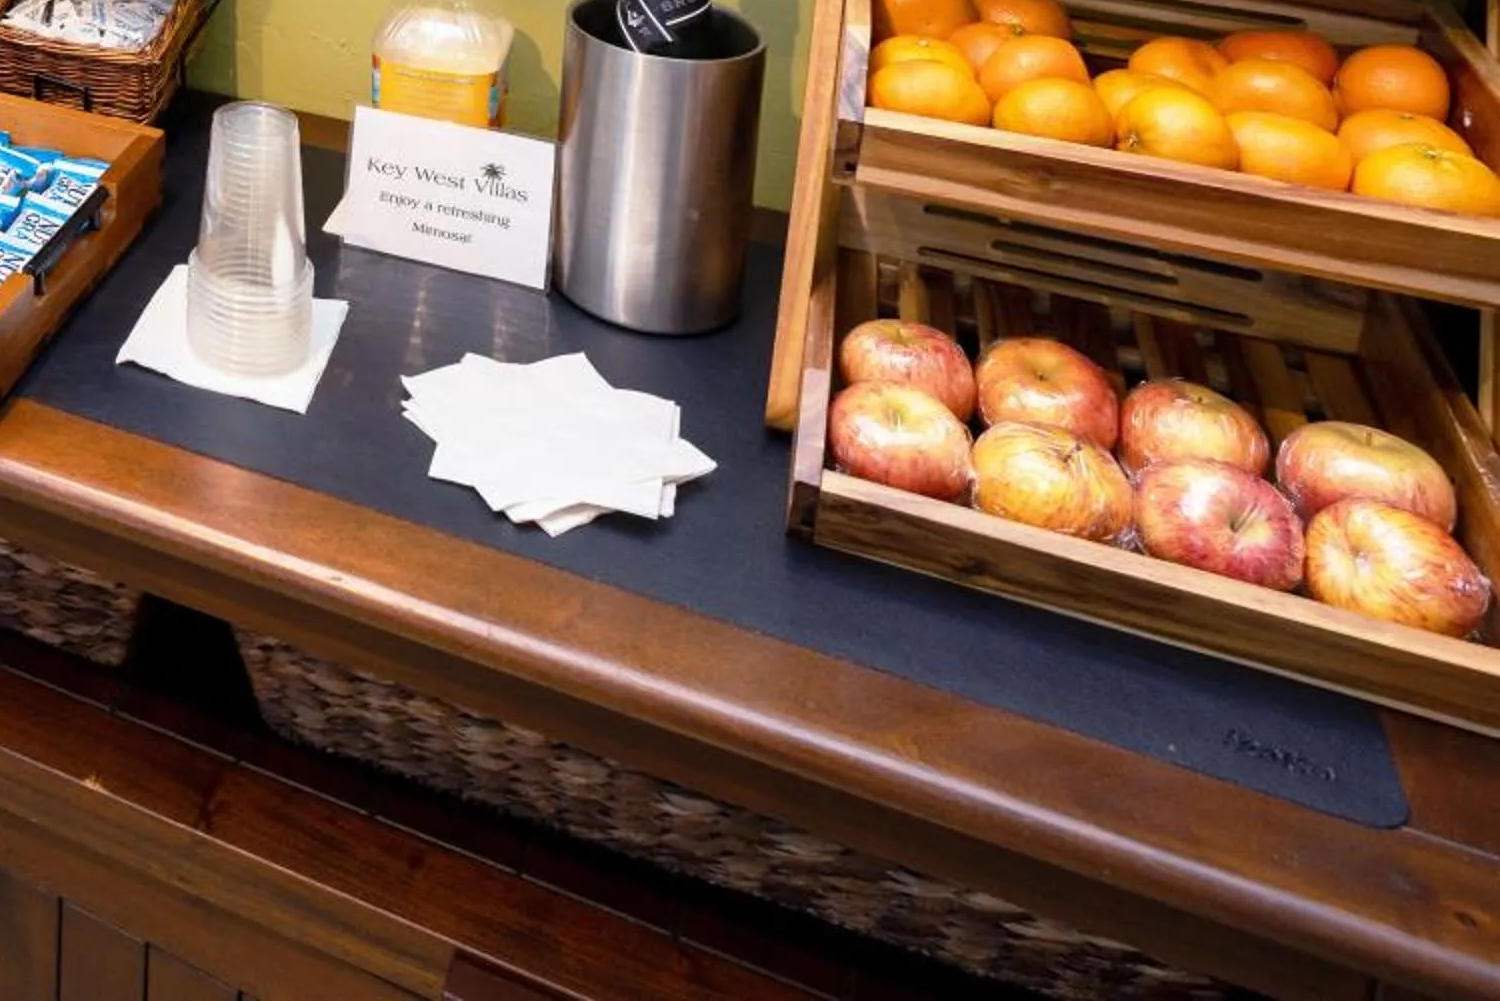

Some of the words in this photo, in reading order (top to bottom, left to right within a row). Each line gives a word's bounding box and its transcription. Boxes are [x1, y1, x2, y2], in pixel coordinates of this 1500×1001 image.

[367, 157, 408, 180] Key
[414, 166, 466, 190] West
[473, 176, 529, 203] Villas
[379, 190, 421, 209] Enjoy
[423, 200, 433, 211] a
[436, 204, 512, 230] refreshing
[412, 221, 473, 245] Mimosa!
